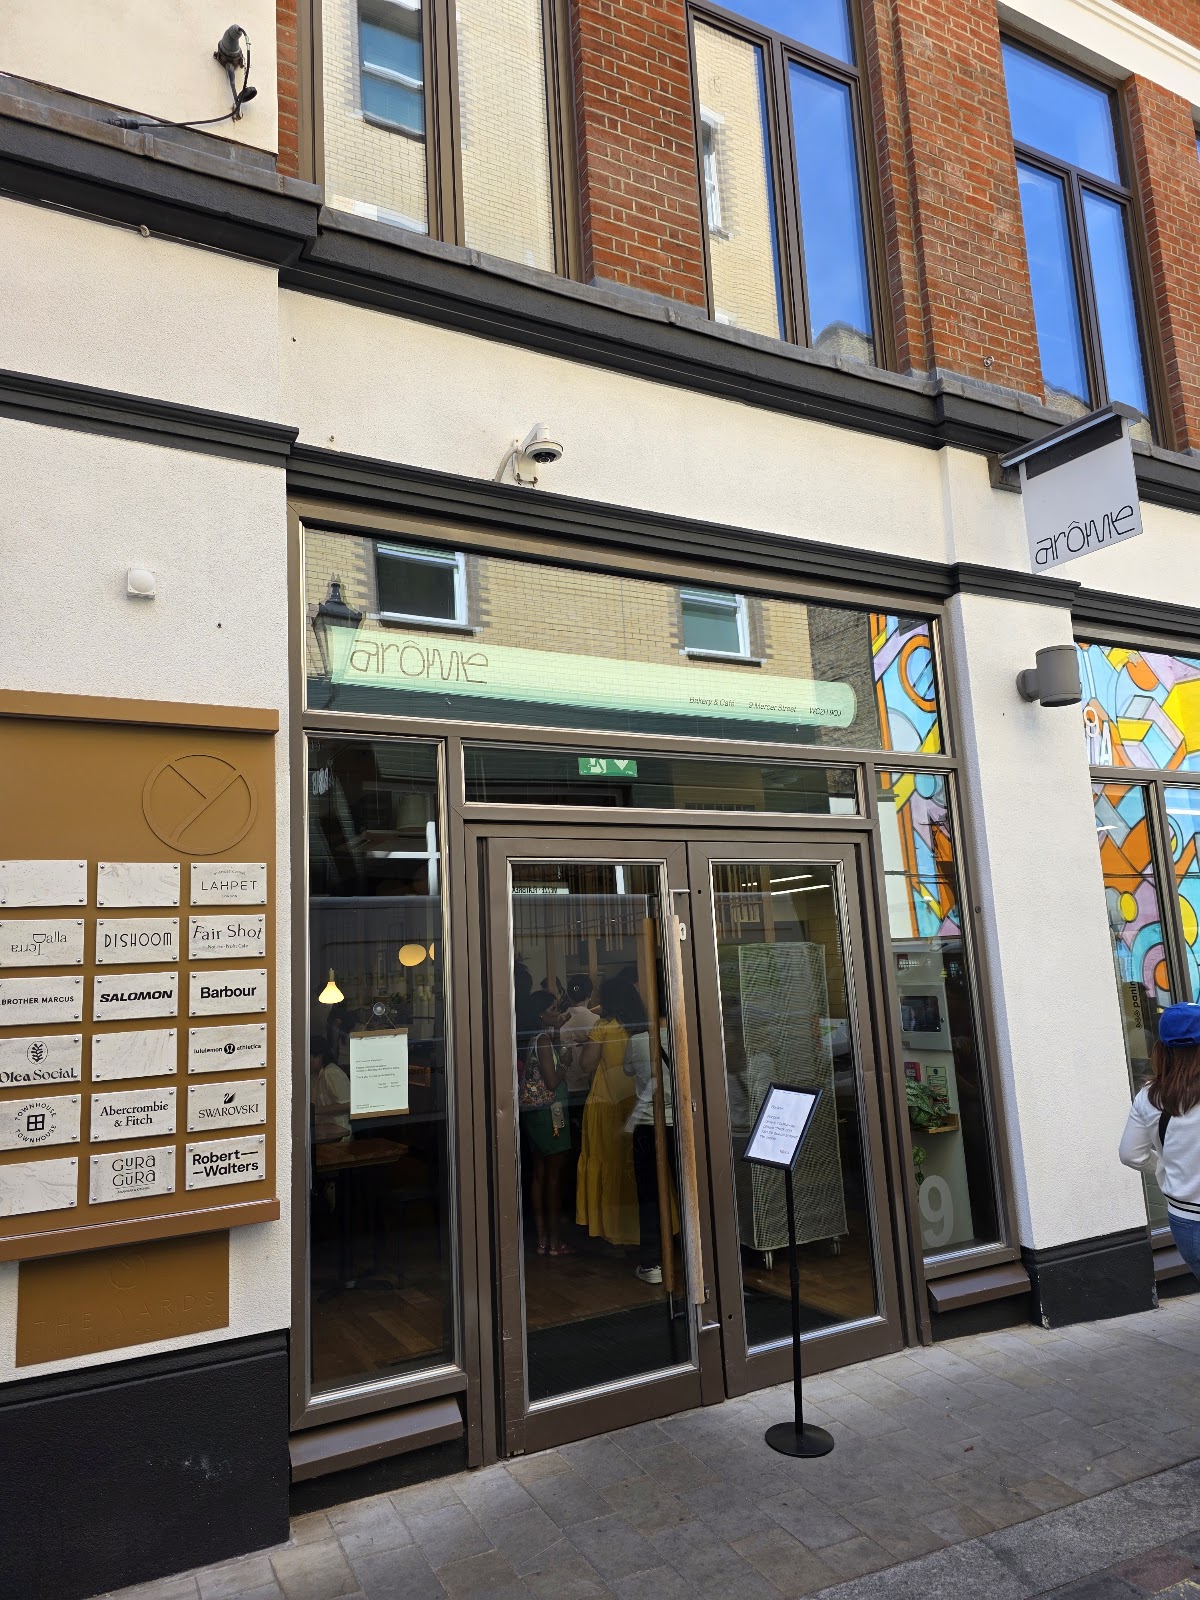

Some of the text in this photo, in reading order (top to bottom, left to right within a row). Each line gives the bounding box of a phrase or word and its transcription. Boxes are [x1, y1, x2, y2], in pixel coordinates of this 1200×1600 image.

[201, 880, 257, 891] LAHPET
[32, 931, 67, 944] Dalla
[104, 932, 172, 948] DISHOOM
[193, 924, 262, 940] Fair Shot
[99, 990, 173, 1003] SALOMON
[200, 985, 257, 999] Barbour
[1, 995, 74, 1006] BROTHER MARCUS
[0, 1067, 76, 1083] Olea Social
[15, 1102, 57, 1121] TOWNHOUSE
[100, 1101, 169, 1117] Abercrombie
[198, 1103, 259, 1119] SWAROVSKI
[113, 1114, 153, 1128] & Fitch
[15, 1124, 57, 1143] TOWNHOUSE
[918, 1174, 954, 1248] 9
